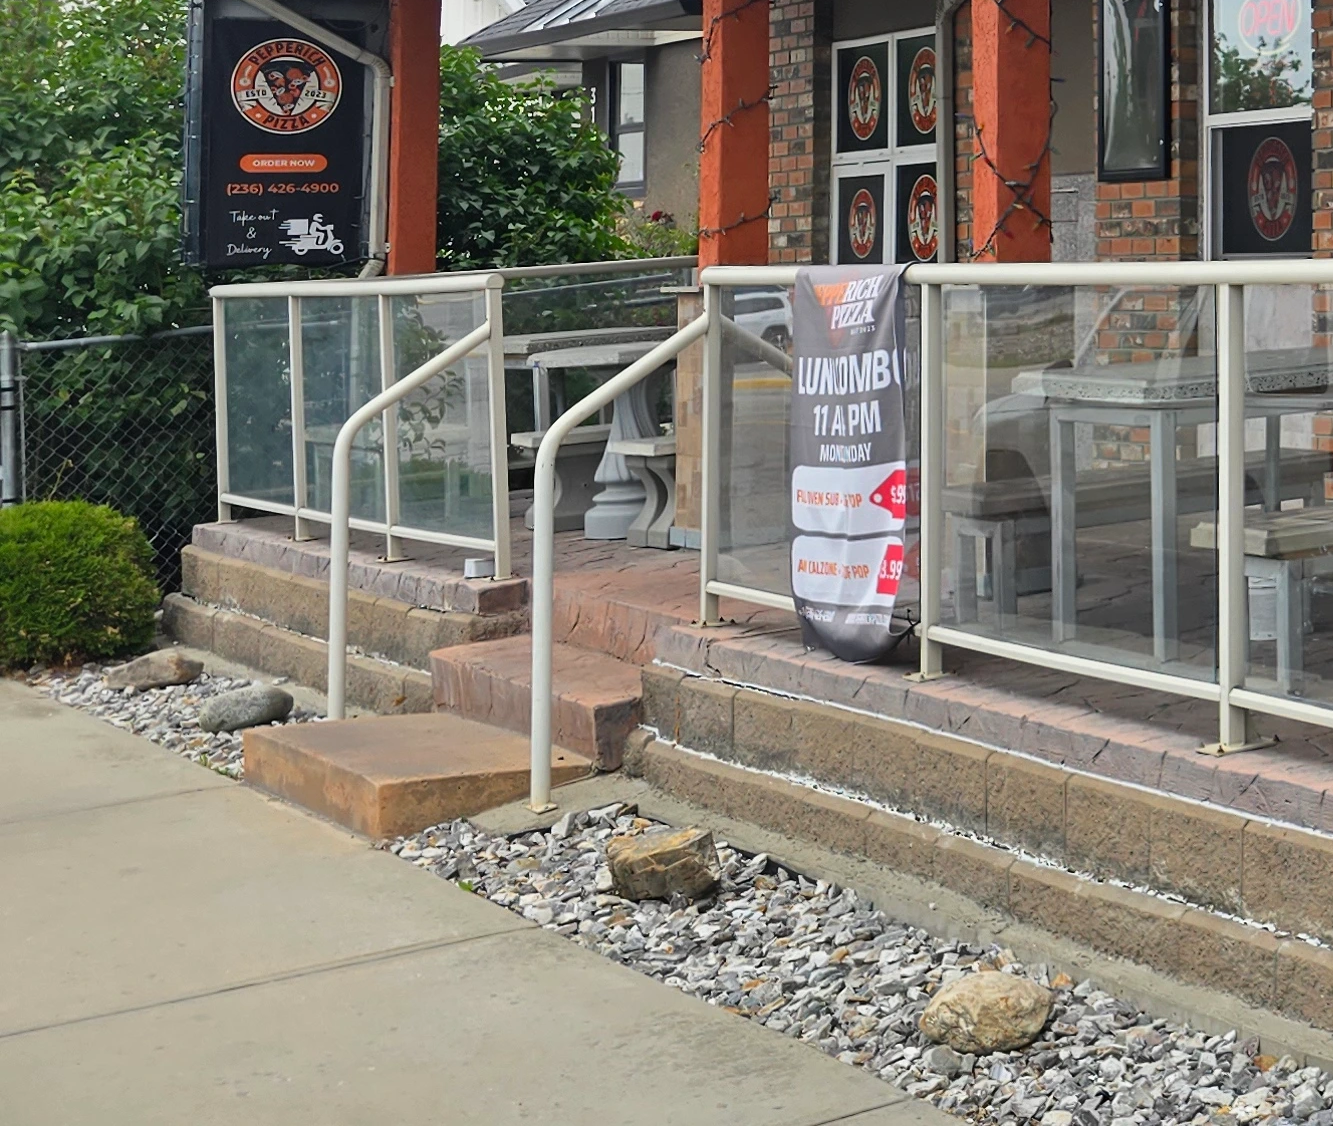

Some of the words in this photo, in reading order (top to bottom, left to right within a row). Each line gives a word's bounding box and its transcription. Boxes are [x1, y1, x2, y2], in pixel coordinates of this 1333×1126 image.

[247, 42, 326, 67] PEPPERICH
[245, 89, 267, 98] ESTD
[304, 89, 327, 99] 2023
[262, 115, 310, 131] PIZZA
[252, 158, 288, 168] ORDER
[289, 158, 316, 168] NOW
[226, 183, 264, 197] (236)
[267, 182, 340, 194] 426-4900
[229, 210, 256, 224] Take
[257, 208, 280, 222] out
[246, 227, 257, 239] &
[226, 244, 273, 260] Delivery
[831, 299, 876, 330] PIZZA
